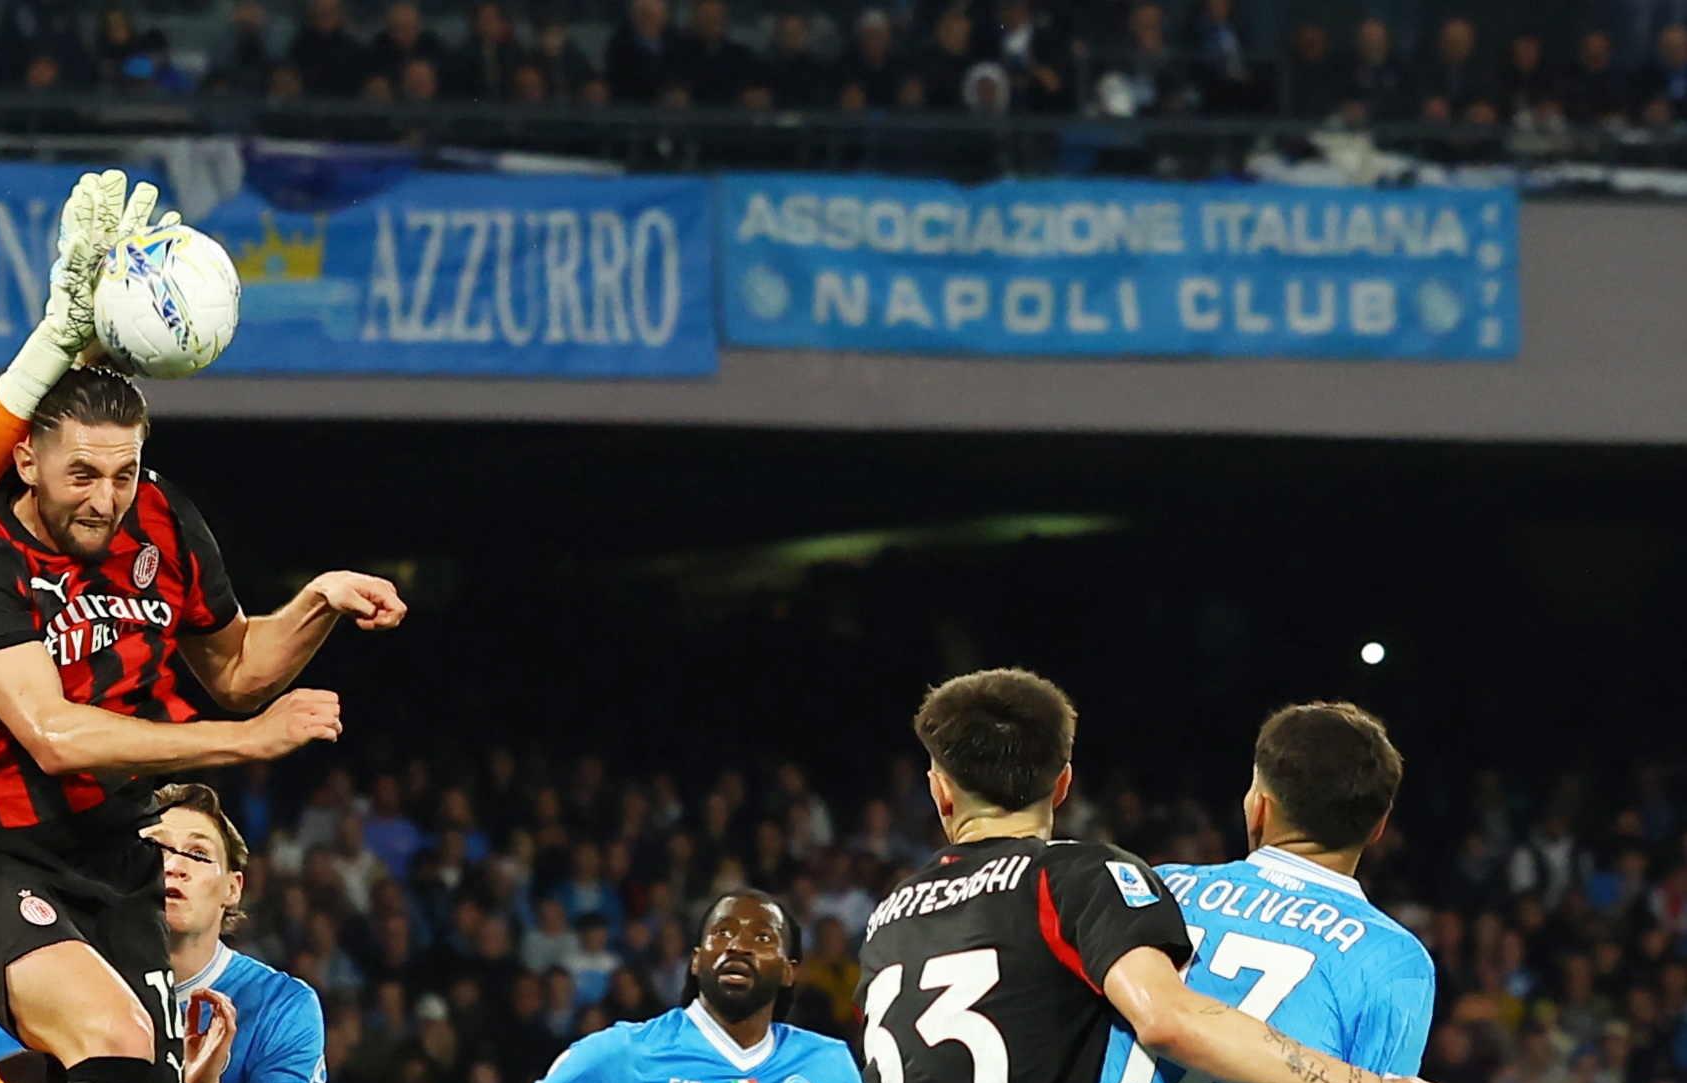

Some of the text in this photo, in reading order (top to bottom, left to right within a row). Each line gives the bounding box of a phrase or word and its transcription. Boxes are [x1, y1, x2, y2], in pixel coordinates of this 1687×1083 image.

[737, 192, 1470, 260] ASSOCIAZIONE ITALIANA
[361, 205, 681, 348] AZZURRO
[812, 269, 1400, 338] NAPOLI CLUB
[1198, 879, 1367, 954] OLIVERA
